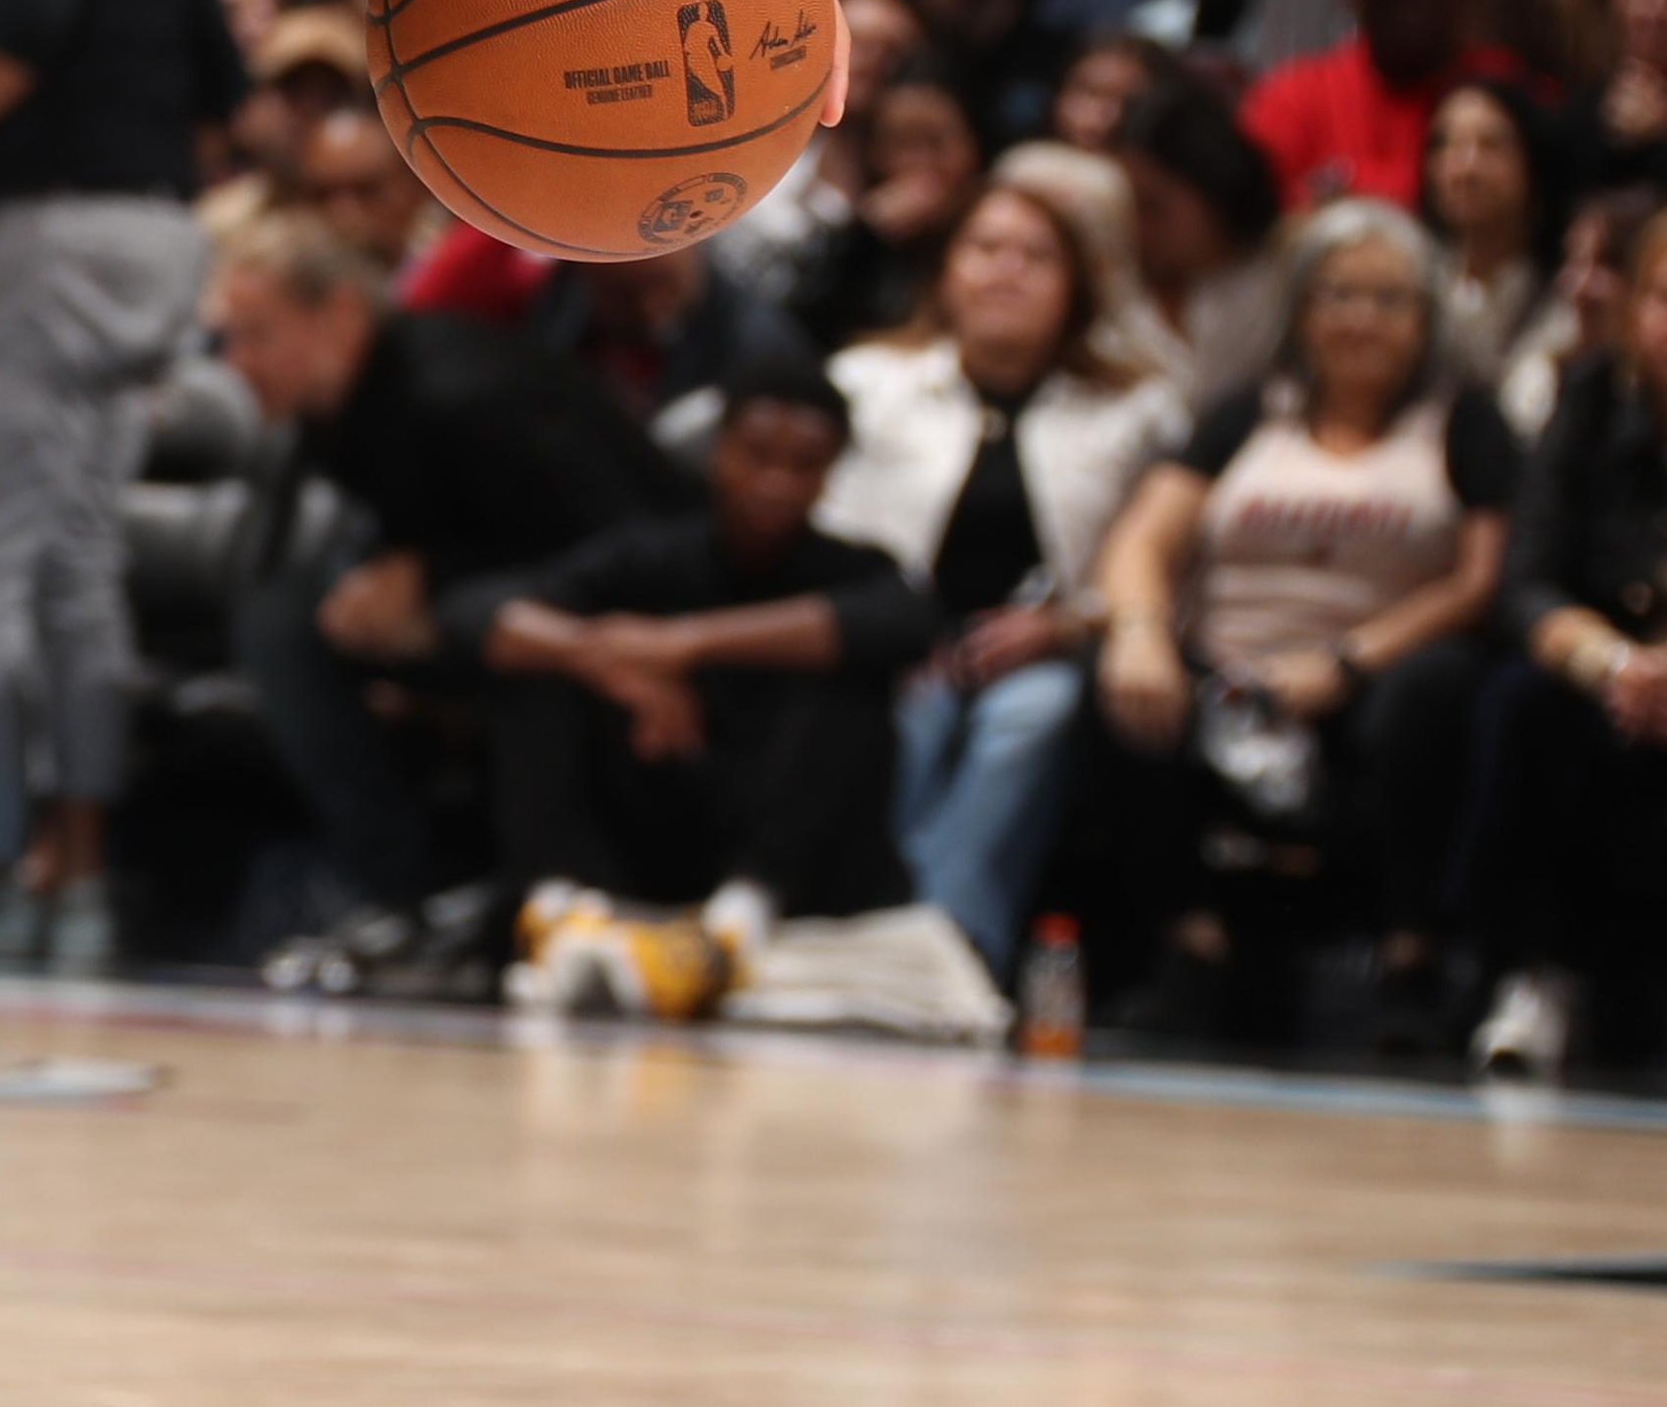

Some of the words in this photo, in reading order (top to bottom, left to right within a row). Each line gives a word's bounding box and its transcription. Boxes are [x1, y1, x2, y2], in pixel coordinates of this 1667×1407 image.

[564, 67, 611, 90] OFFICIAL
[614, 63, 643, 85] GAME
[645, 60, 670, 80] BALL
